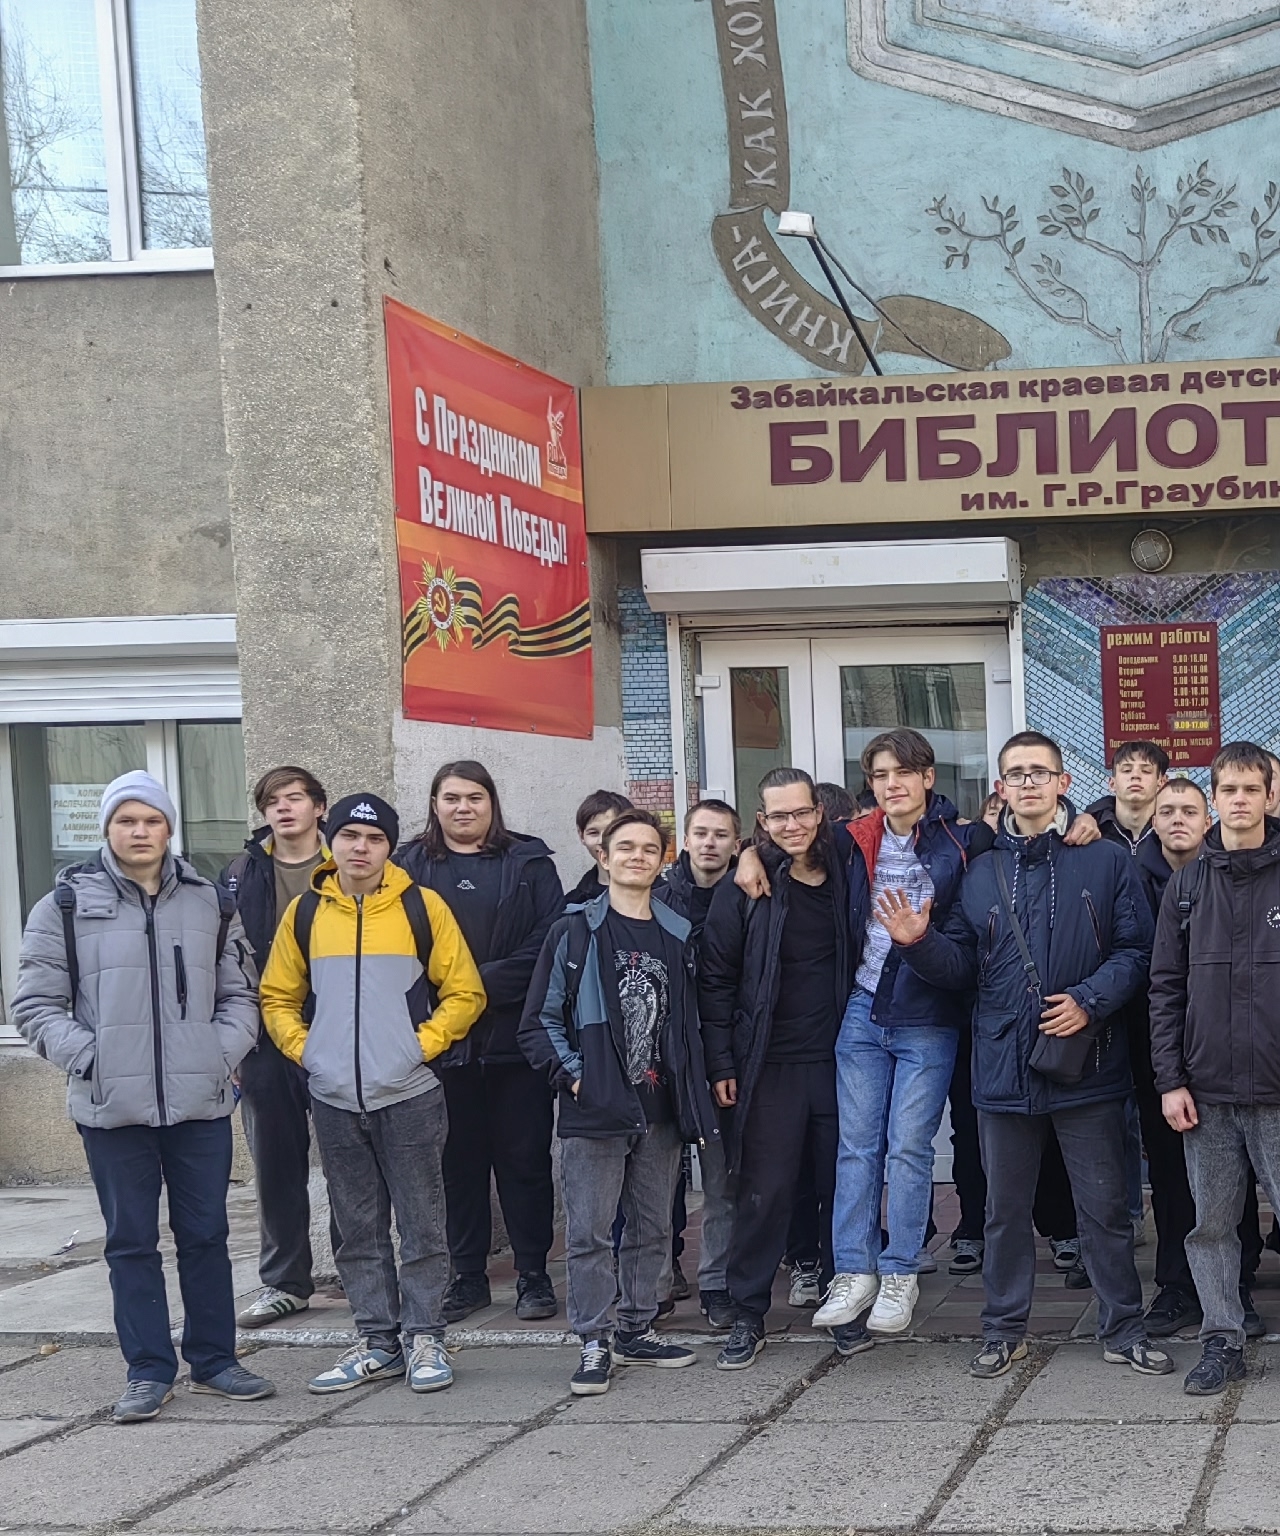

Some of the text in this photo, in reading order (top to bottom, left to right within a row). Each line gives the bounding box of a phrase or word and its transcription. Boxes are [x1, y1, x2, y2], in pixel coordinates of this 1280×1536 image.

[725, 0, 769, 69] ХО
[738, 88, 778, 189] КАК
[730, 381, 1009, 410] Забайкальская
[1018, 373, 1170, 402] краевая
[415, 386, 430, 446] С
[960, 491, 1030, 512] им.
[1106, 628, 1210, 649] режим работы
